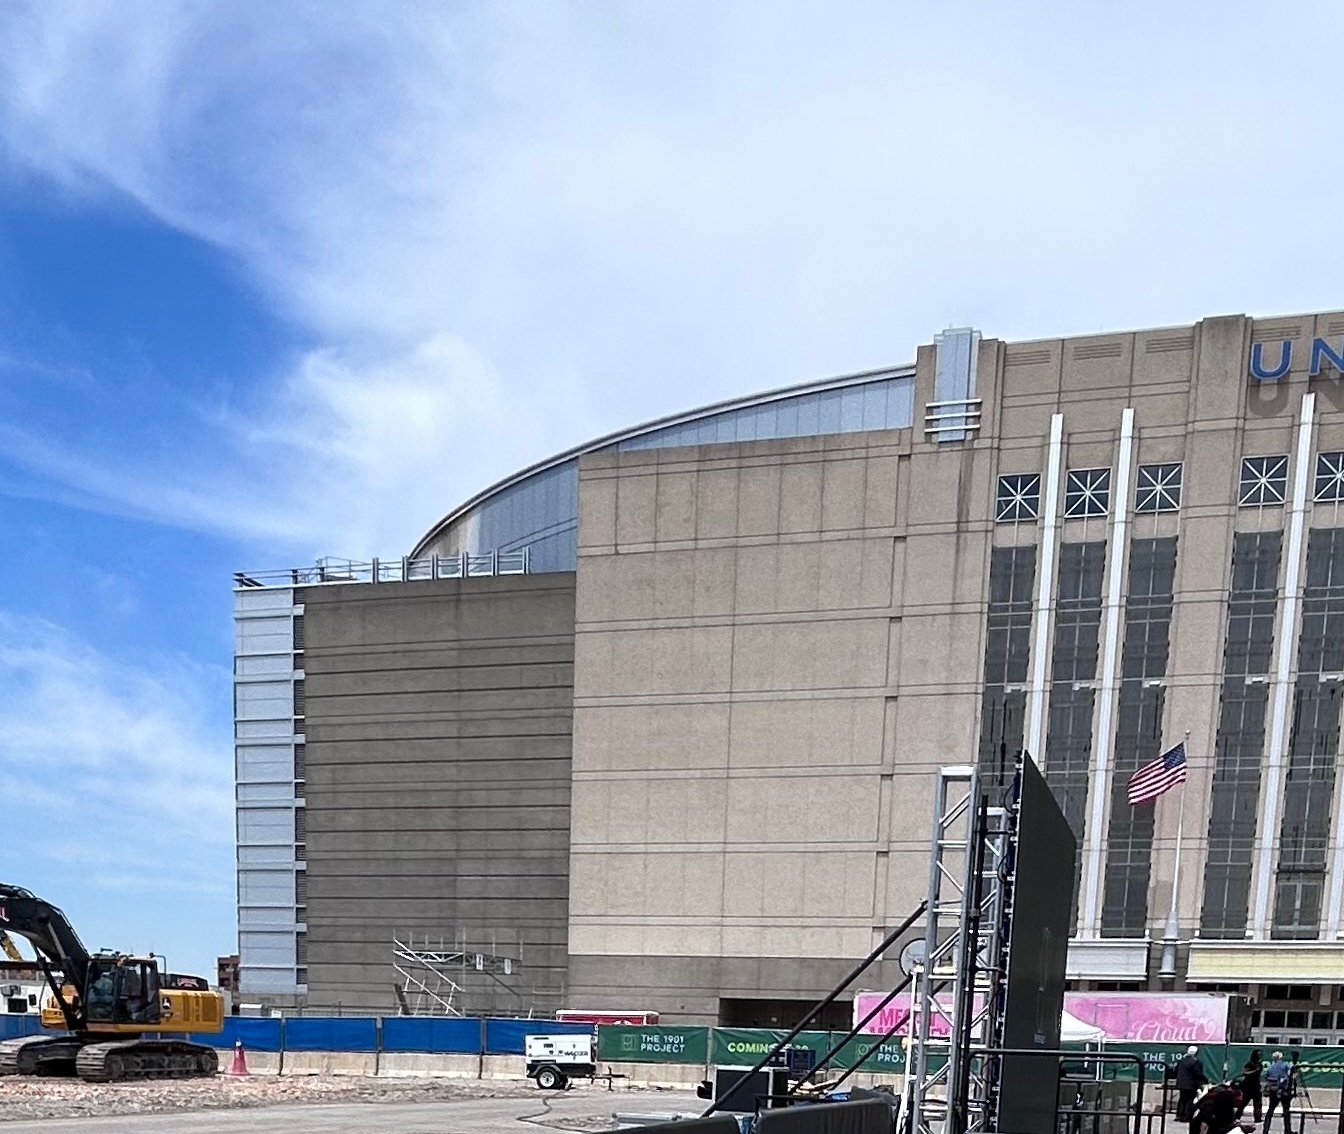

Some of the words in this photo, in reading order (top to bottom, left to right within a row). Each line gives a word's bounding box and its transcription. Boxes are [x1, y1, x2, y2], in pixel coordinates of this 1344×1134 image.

[641, 1034, 660, 1044] THE
[663, 1034, 684, 1044] 1901
[640, 1043, 685, 1053] PROJECT
